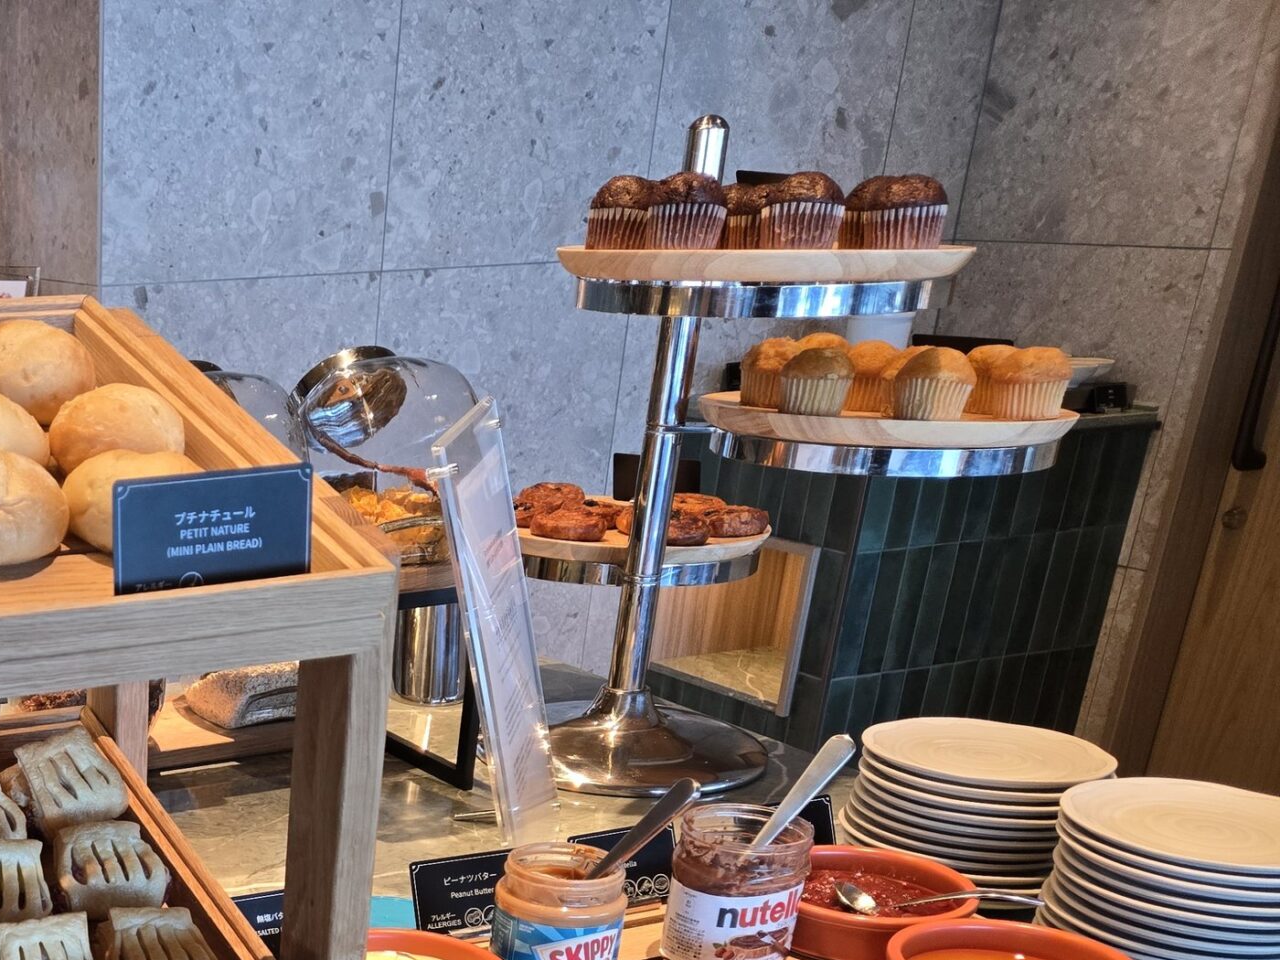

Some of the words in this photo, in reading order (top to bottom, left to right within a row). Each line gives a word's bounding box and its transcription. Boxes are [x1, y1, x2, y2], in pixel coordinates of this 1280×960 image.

[175, 506, 256, 525] プチナチュール
[180, 527, 209, 540] PETIT
[210, 523, 250, 536] NATURE
[166, 544, 193, 558] (MINI
[195, 541, 224, 554] PLAIN
[226, 537, 263, 551] BREAD)
[451, 889, 473, 899] Peanut
[474, 887, 494, 896] Butter
[427, 919, 462, 930] ALLERGIES
